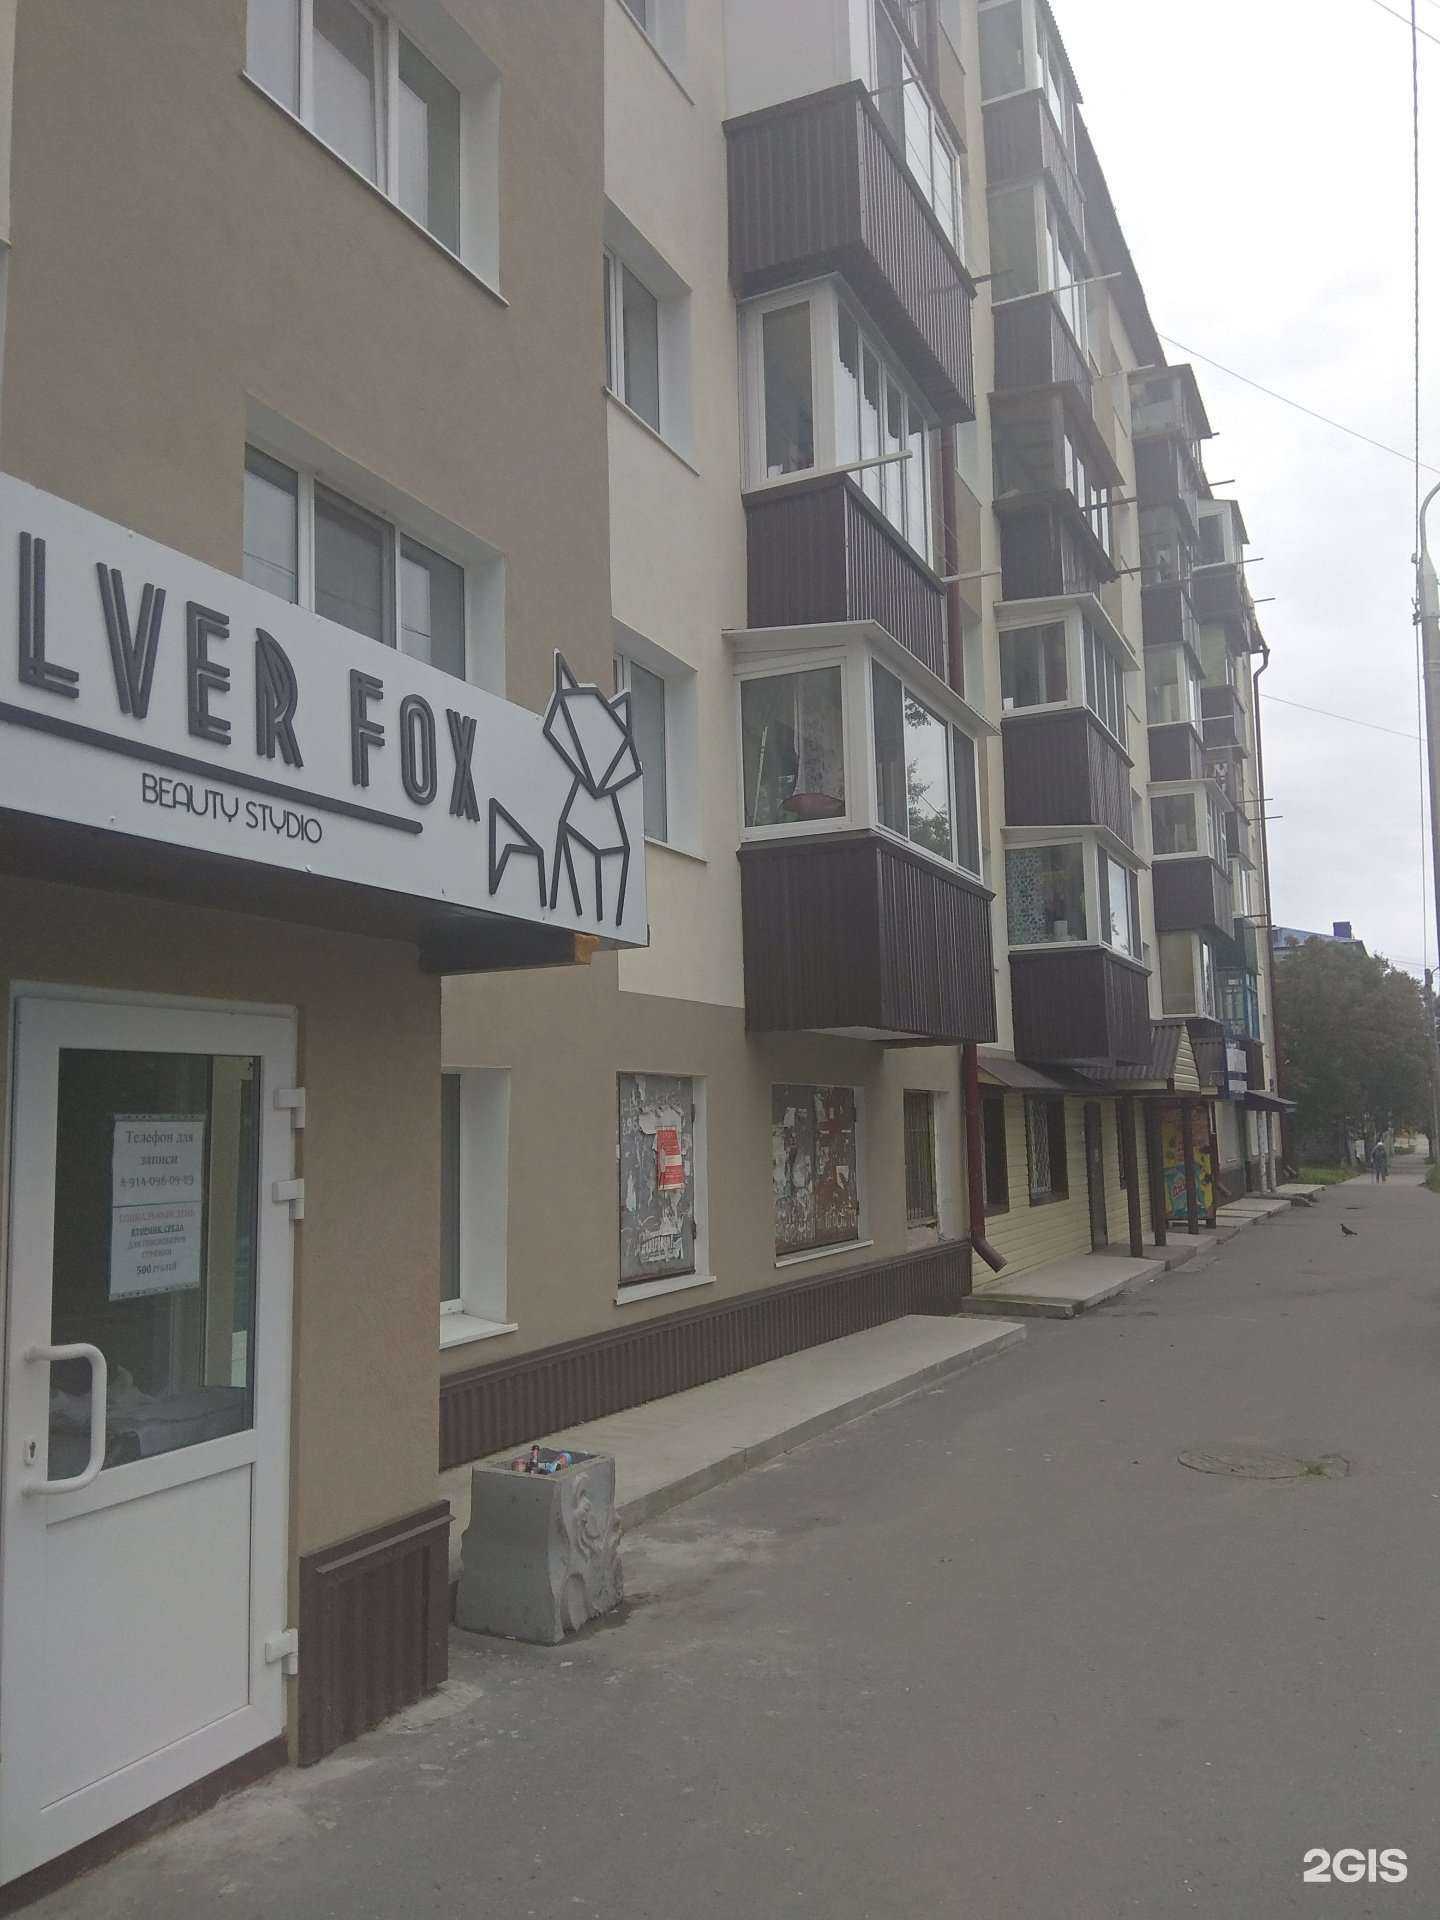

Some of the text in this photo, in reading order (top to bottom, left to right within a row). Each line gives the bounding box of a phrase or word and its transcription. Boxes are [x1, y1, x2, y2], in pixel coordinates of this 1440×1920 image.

[350, 668, 481, 822] FOX
[142, 772, 239, 823] BEAUTY
[125, 1130, 173, 1146] Телефон
[139, 1154, 179, 1166] записи
